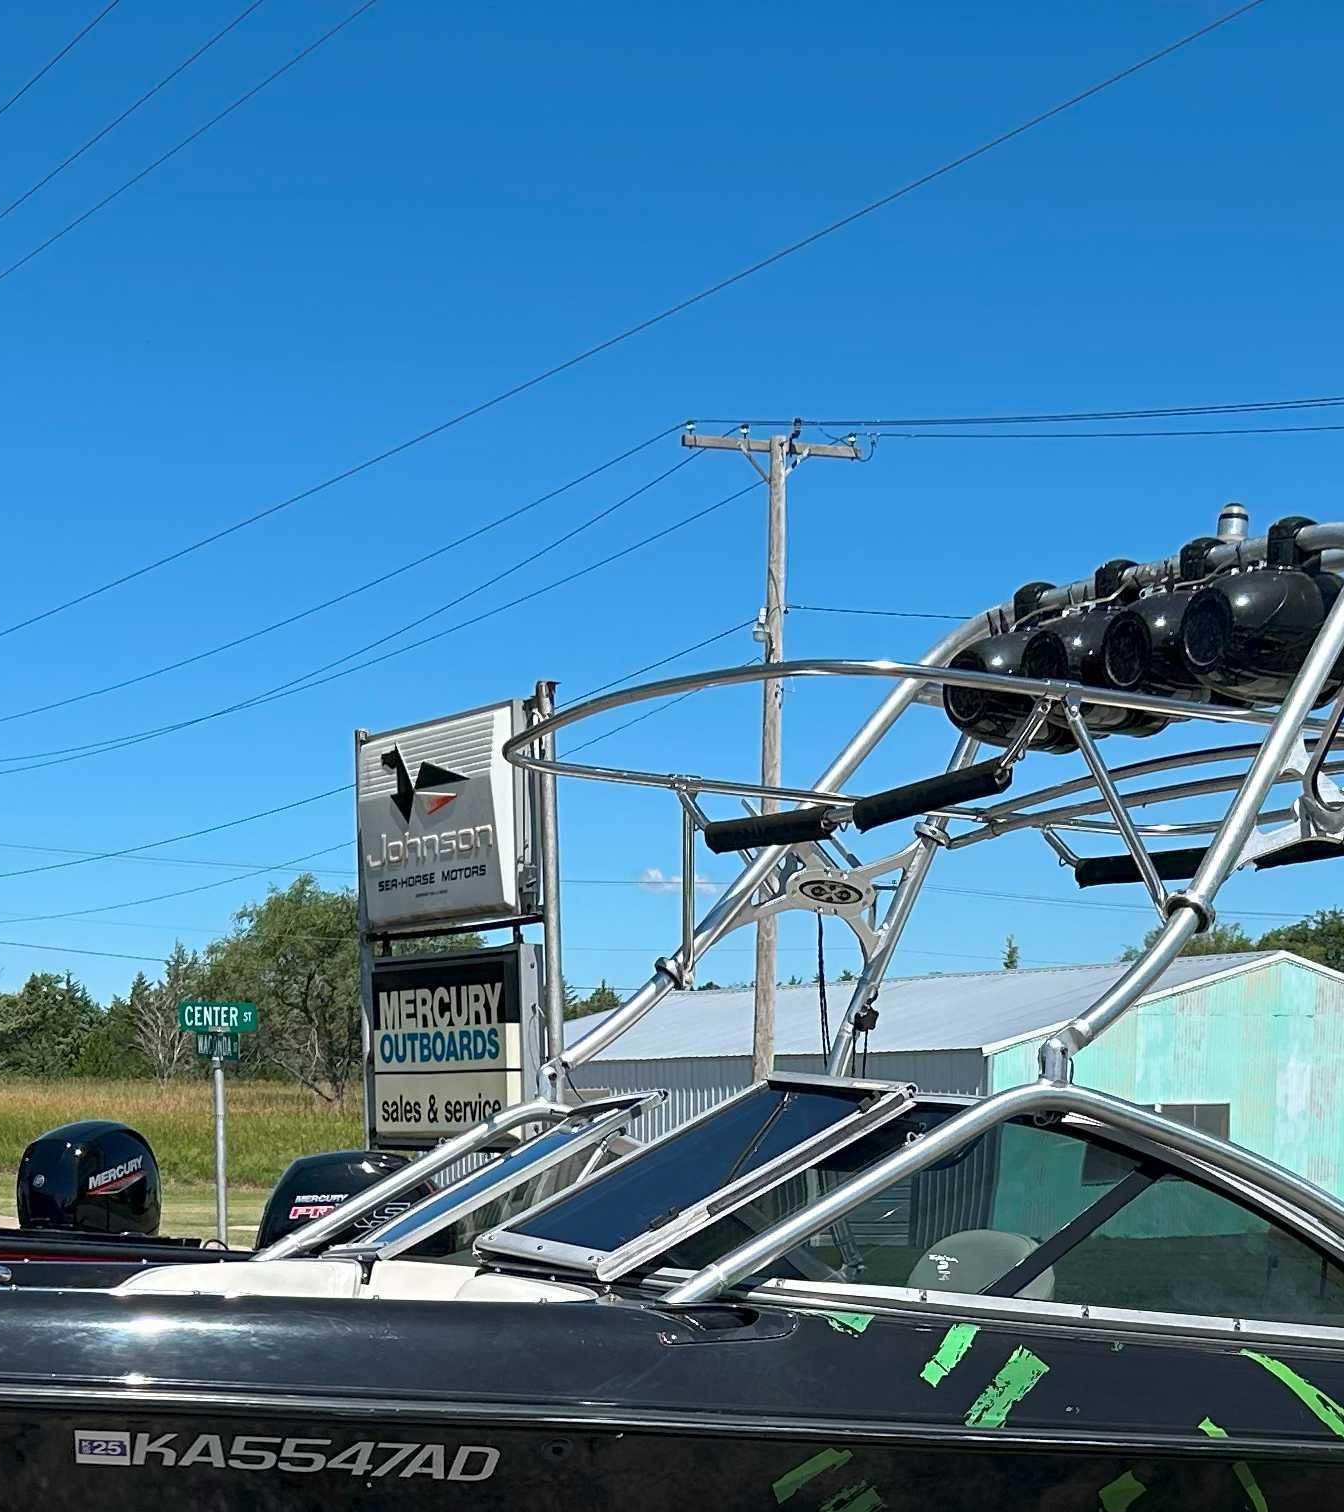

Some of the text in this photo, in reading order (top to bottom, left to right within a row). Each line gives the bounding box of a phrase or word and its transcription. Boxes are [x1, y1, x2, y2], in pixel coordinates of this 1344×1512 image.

[367, 824, 493, 868] Johnson
[378, 864, 487, 892] SEA-HORSE MOTORS
[184, 1005, 253, 1027] CENTER ST
[379, 982, 503, 1030] MERCURY
[380, 1028, 500, 1064] OUTBOARDS
[382, 1092, 502, 1123] sales & service
[88, 1155, 143, 1190] MERCURY
[289, 1205, 337, 1220] PR
[294, 1193, 349, 1204] MERCURY
[93, 1441, 122, 1455] 25
[131, 1432, 501, 1482] KA5547AD
